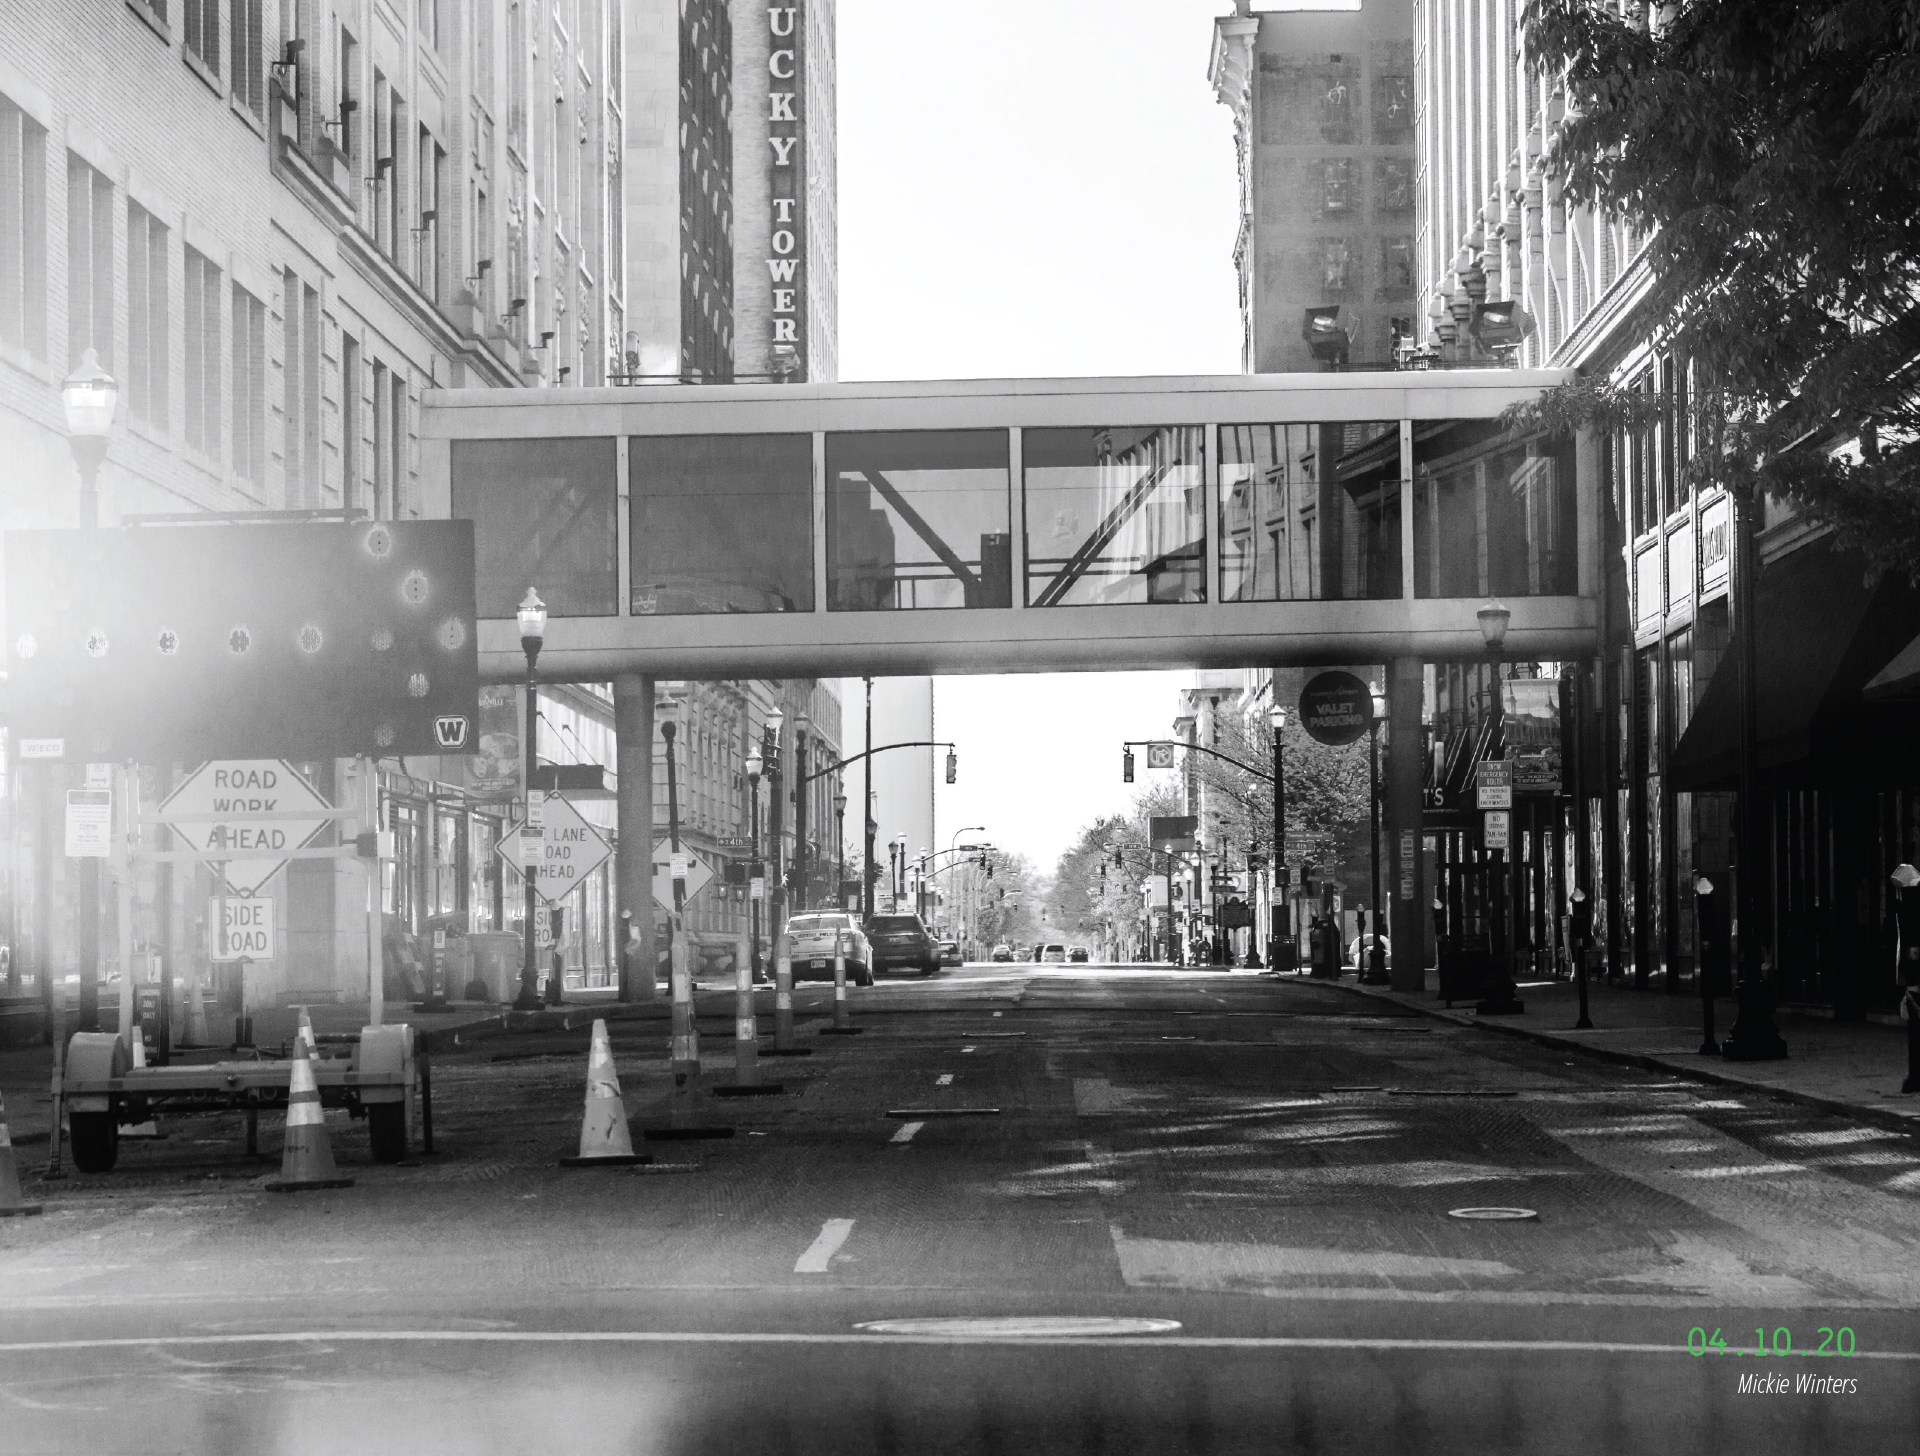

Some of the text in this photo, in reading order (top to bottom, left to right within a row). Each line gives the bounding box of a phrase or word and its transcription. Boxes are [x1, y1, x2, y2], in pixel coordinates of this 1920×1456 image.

[765, 198, 799, 342] TOWER
[1316, 703, 1355, 715] VALET
[1309, 714, 1364, 728] PARKING
[439, 721, 463, 742] W
[25, 742, 60, 754] WECO
[214, 769, 277, 789] ROAD
[554, 828, 587, 842] LANE
[730, 837, 743, 846] 4th
[546, 845, 571, 859] OAD
[226, 931, 267, 951] OAD
